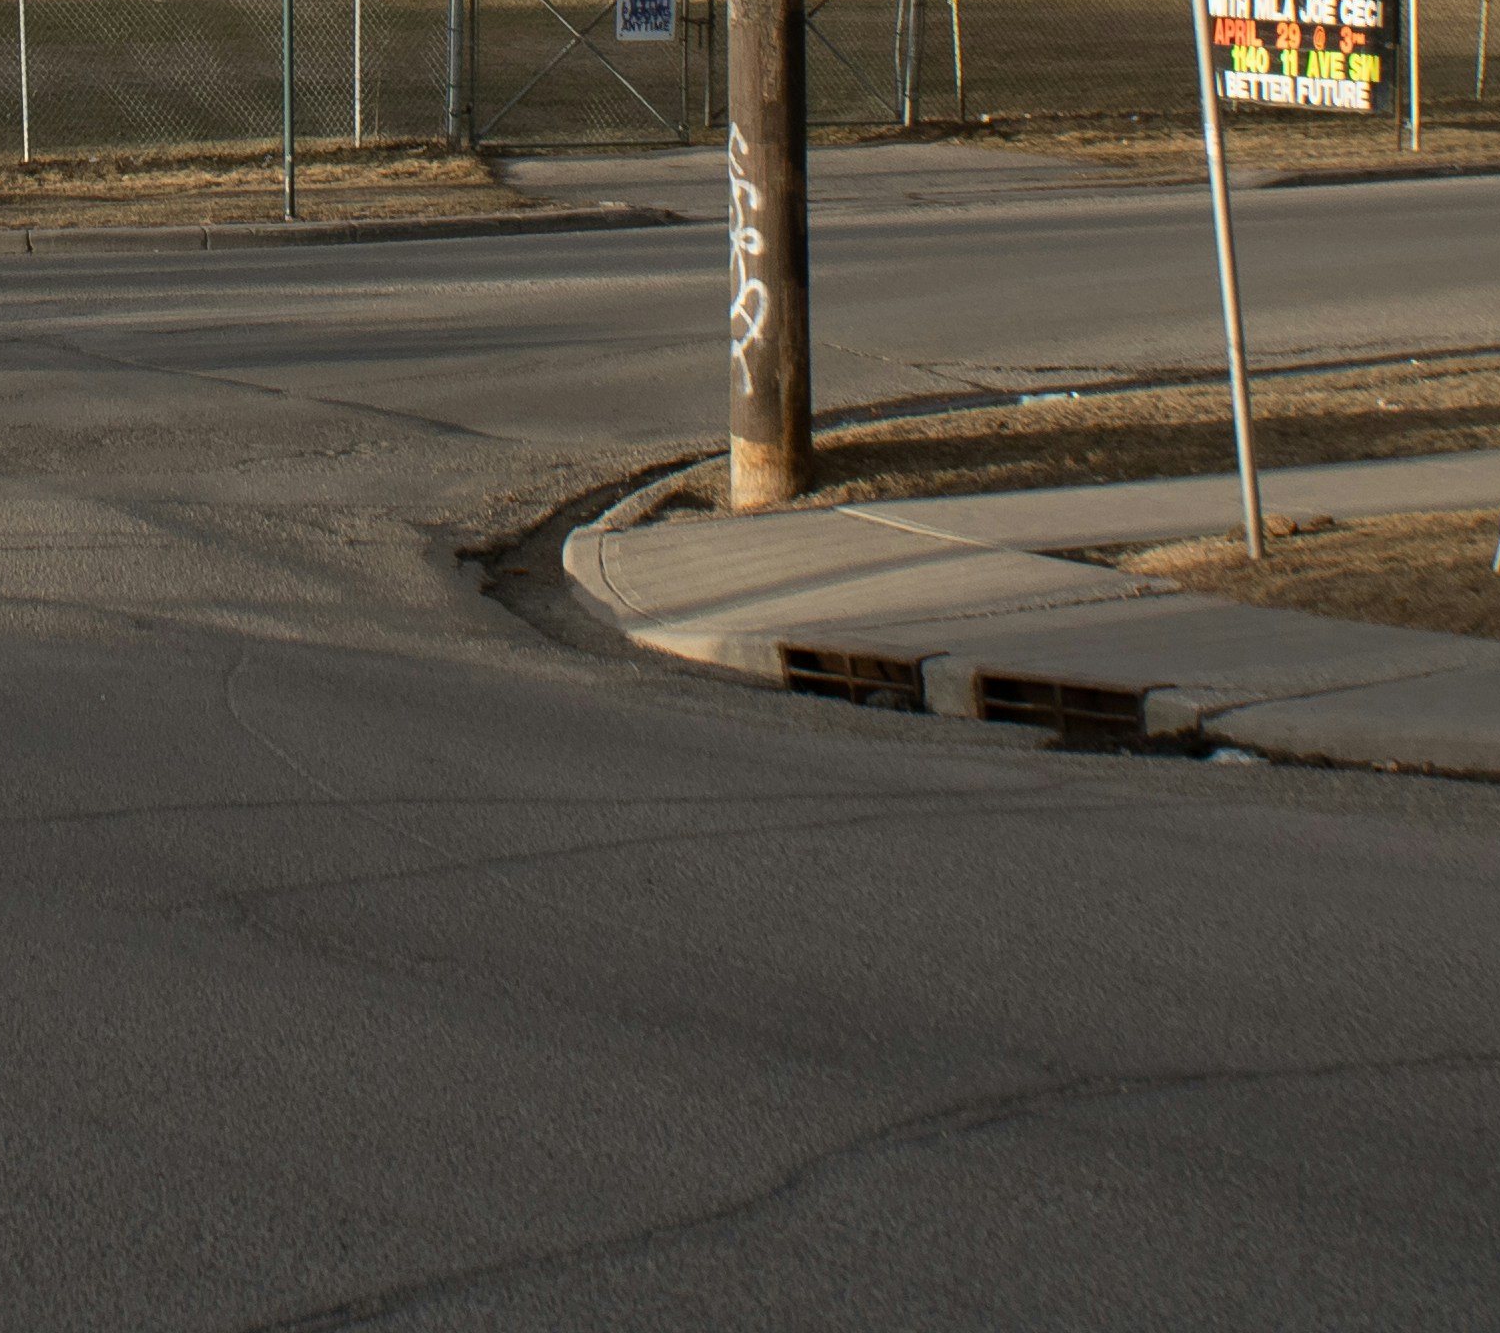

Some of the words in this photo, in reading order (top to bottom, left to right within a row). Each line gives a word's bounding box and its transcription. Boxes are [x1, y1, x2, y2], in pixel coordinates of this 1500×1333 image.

[1214, 18, 1262, 46] APRIL
[1277, 22, 1301, 49] 29
[1313, 26, 1326, 50] @
[1231, 45, 1270, 73] 1140
[1281, 49, 1298, 76] 11
[1307, 50, 1345, 79] AVE
[1349, 53, 1380, 82] SW
[1225, 70, 1295, 103] BETTER
[1297, 76, 1371, 109] FUTURE
